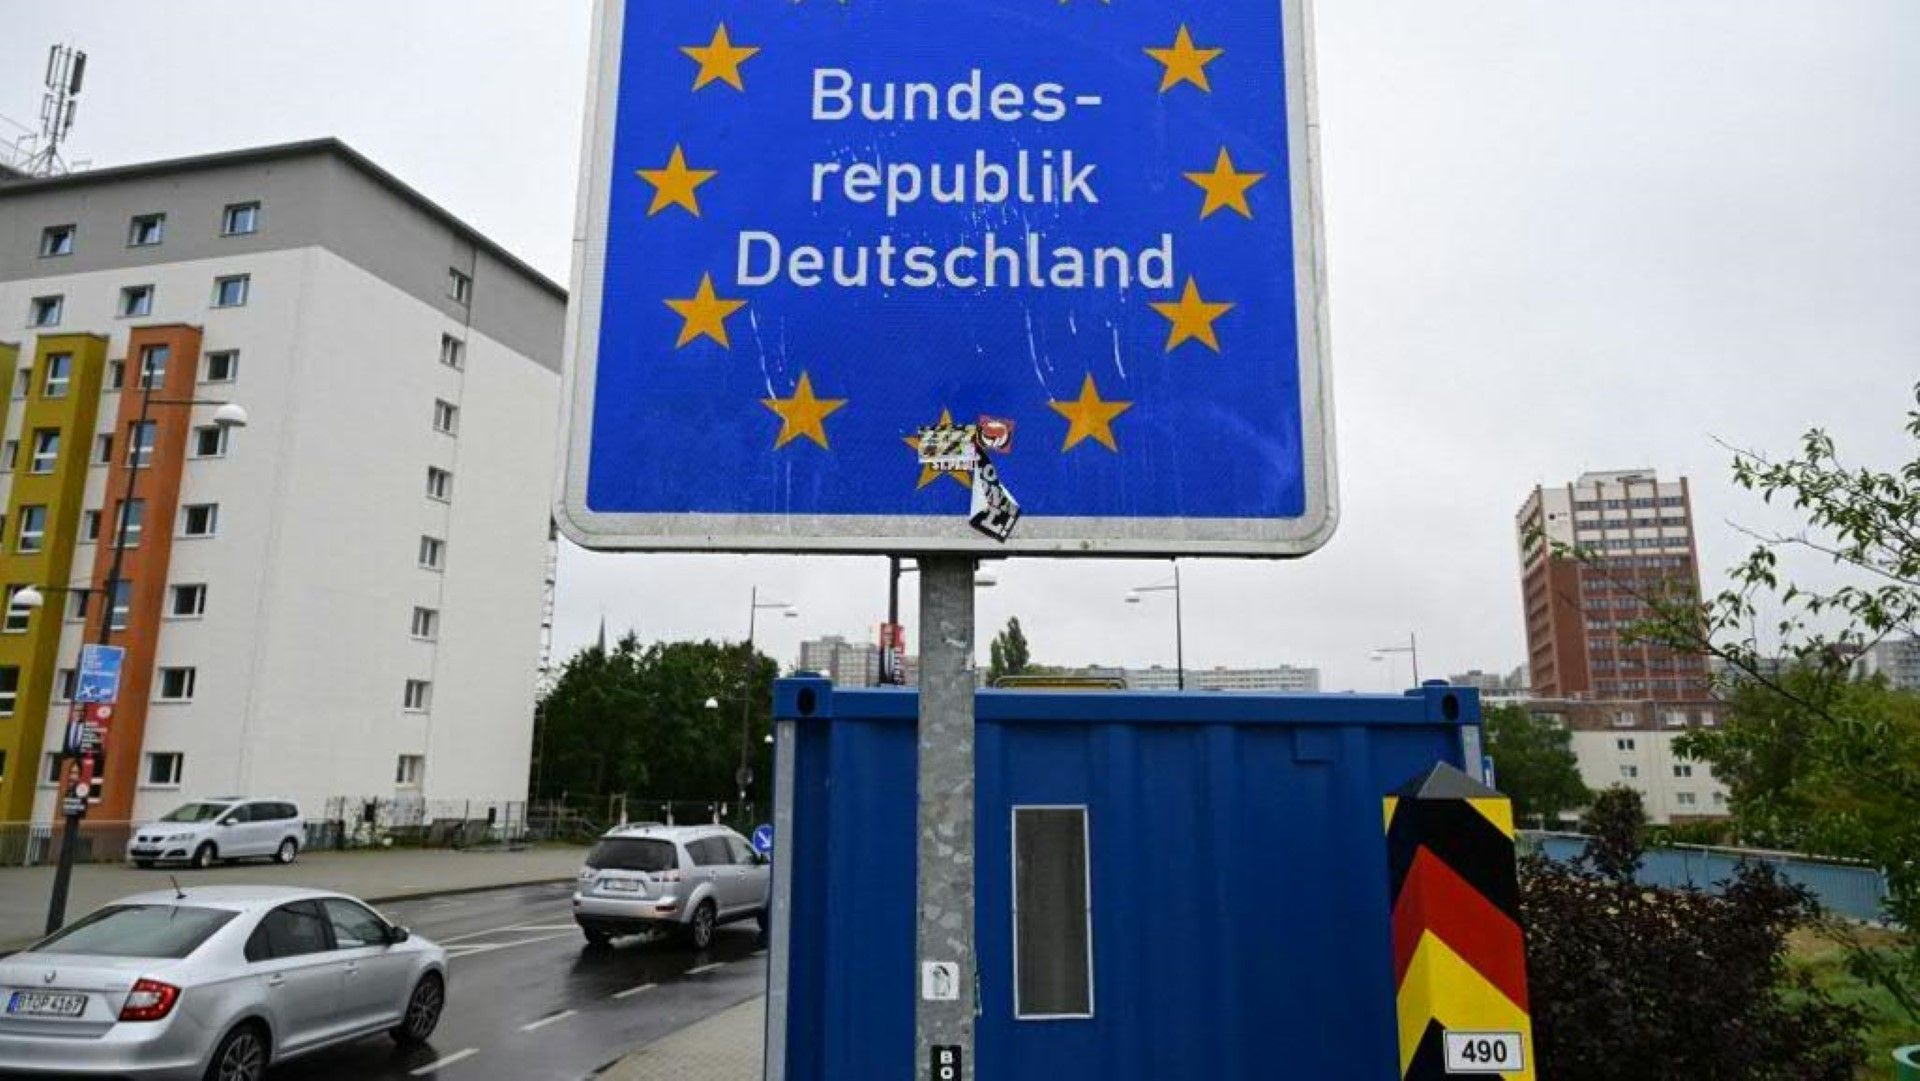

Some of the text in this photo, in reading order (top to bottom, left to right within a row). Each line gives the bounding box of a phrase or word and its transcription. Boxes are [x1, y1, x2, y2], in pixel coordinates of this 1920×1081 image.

[811, 68, 1102, 121] Bundes-
[811, 149, 1099, 217] republik
[737, 230, 1174, 288] Deutschland
[1461, 1039, 1507, 1063] 490
